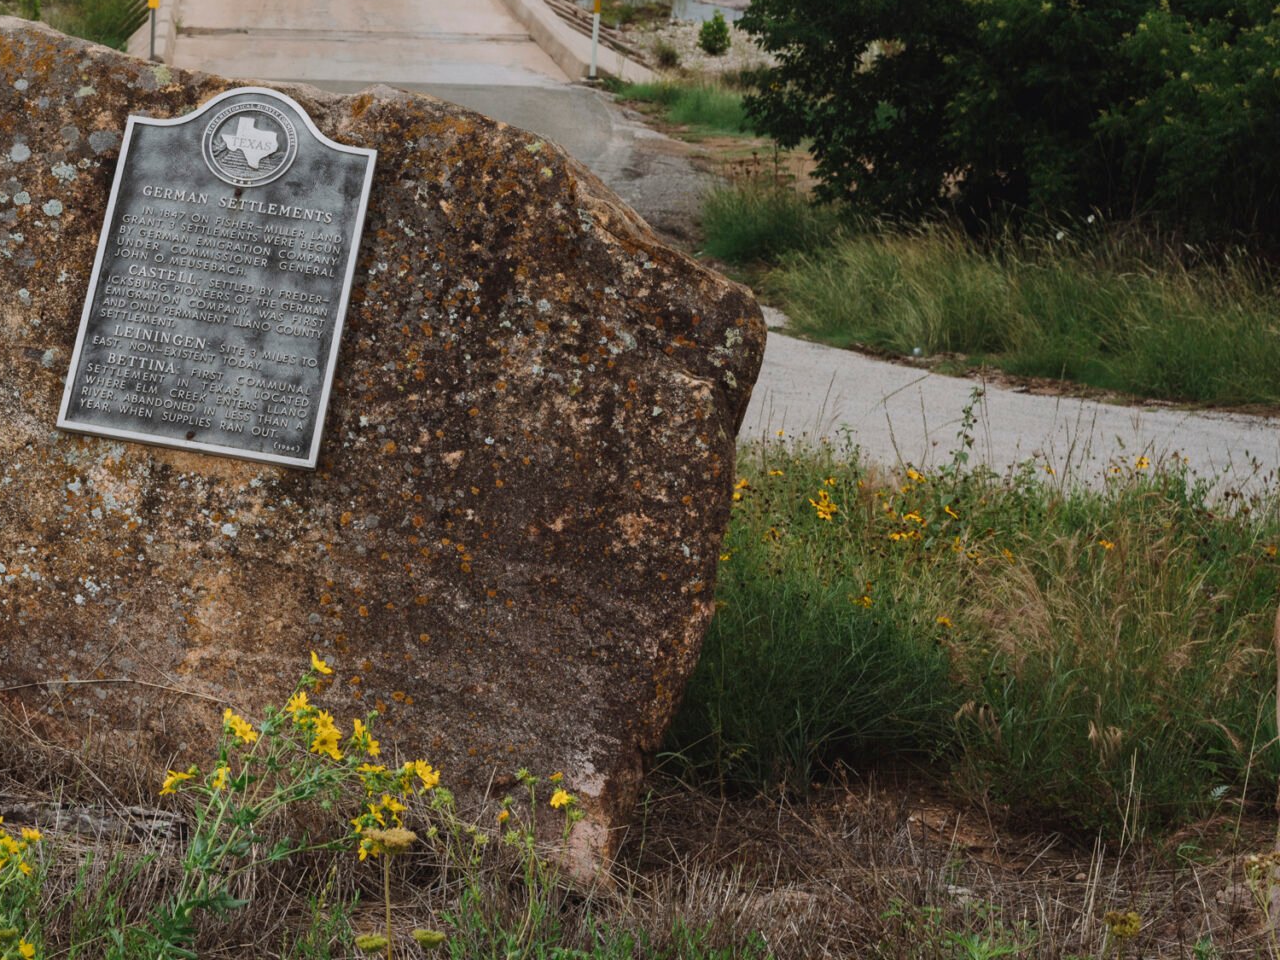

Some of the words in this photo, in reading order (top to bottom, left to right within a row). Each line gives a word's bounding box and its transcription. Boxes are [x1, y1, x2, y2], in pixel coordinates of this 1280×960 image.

[207, 116, 222, 135] STATE
[257, 104, 280, 117] SURVEY
[233, 137, 272, 151] TEXAS
[142, 185, 209, 205] GERMAN
[218, 196, 334, 223] SETTLEMENTS
[143, 207, 155, 215] IN
[160, 209, 186, 220] 1847
[191, 214, 209, 224] ON
[215, 217, 306, 238] FISHER-MILLER
[311, 231, 342, 243] LAND
[169, 222, 175, 230] 3
[180, 224, 259, 242] SETTLEMENTS
[263, 236, 296, 248] WERE
[300, 242, 340, 255] BEGUN
[115, 248, 148, 261] JOHN
[154, 254, 166, 264] O.
[170, 257, 247, 276] MEUSEBACH.
[117, 237, 160, 251] UNDER
[171, 245, 268, 267] COMMISSIONER
[279, 262, 335, 277] GENERAL
[120, 226, 135, 235] BY
[139, 229, 189, 244] GERMAN
[196, 237, 271, 256] EMIGRATION
[278, 250, 338, 266] COMPANY
[108, 275, 168, 292] ICKSBURG
[174, 286, 230, 302] PIONEERS
[235, 295, 252, 305] OF
[255, 298, 277, 309] THE
[280, 302, 328, 317] GERMAN
[129, 265, 203, 285] CASTELL:
[208, 279, 255, 294] SETTLED
[260, 287, 273, 296] BY
[279, 290, 330, 305] FREDER-
[100, 309, 176, 328] SETTLEMENT.
[103, 298, 126, 309] AND
[129, 302, 160, 314] ONLY
[163, 307, 228, 325] PERMANENT
[233, 318, 271, 331] LLANO
[276, 324, 323, 340] COUNTY
[105, 286, 181, 305] EMIGRATION
[259, 310, 285, 322] WAS
[292, 315, 325, 328] FIRST
[114, 325, 212, 350] LEININGEN:
[220, 344, 246, 355] SITE
[251, 349, 257, 357] 3
[263, 350, 297, 363] MILES
[302, 357, 318, 367] TO
[129, 342, 216, 363] NON-EXISTENT
[223, 357, 263, 371] TODAY.
[87, 364, 166, 384] SETTLEMENT
[177, 378, 189, 388] IN
[254, 391, 310, 407] LOCATED
[108, 353, 181, 374] BETTINA:
[191, 369, 224, 382] FIRST
[236, 376, 312, 396] COMMUNAL
[85, 375, 126, 390] WHERE
[136, 384, 158, 395] ELM
[169, 389, 207, 403] CREEK
[216, 397, 258, 411] ENTERS
[267, 405, 307, 419] LLANO
[123, 394, 196, 413] ABANDONED
[203, 407, 216, 416] IN
[225, 410, 250, 422] LESS
[257, 415, 289, 428] THAN
[295, 421, 304, 431] A
[79, 398, 112, 412] YEAR,
[119, 405, 153, 419] WHEN
[162, 412, 212, 428] SUPPLIES
[219, 421, 243, 433] RAN
[251, 426, 280, 439] OUT.
